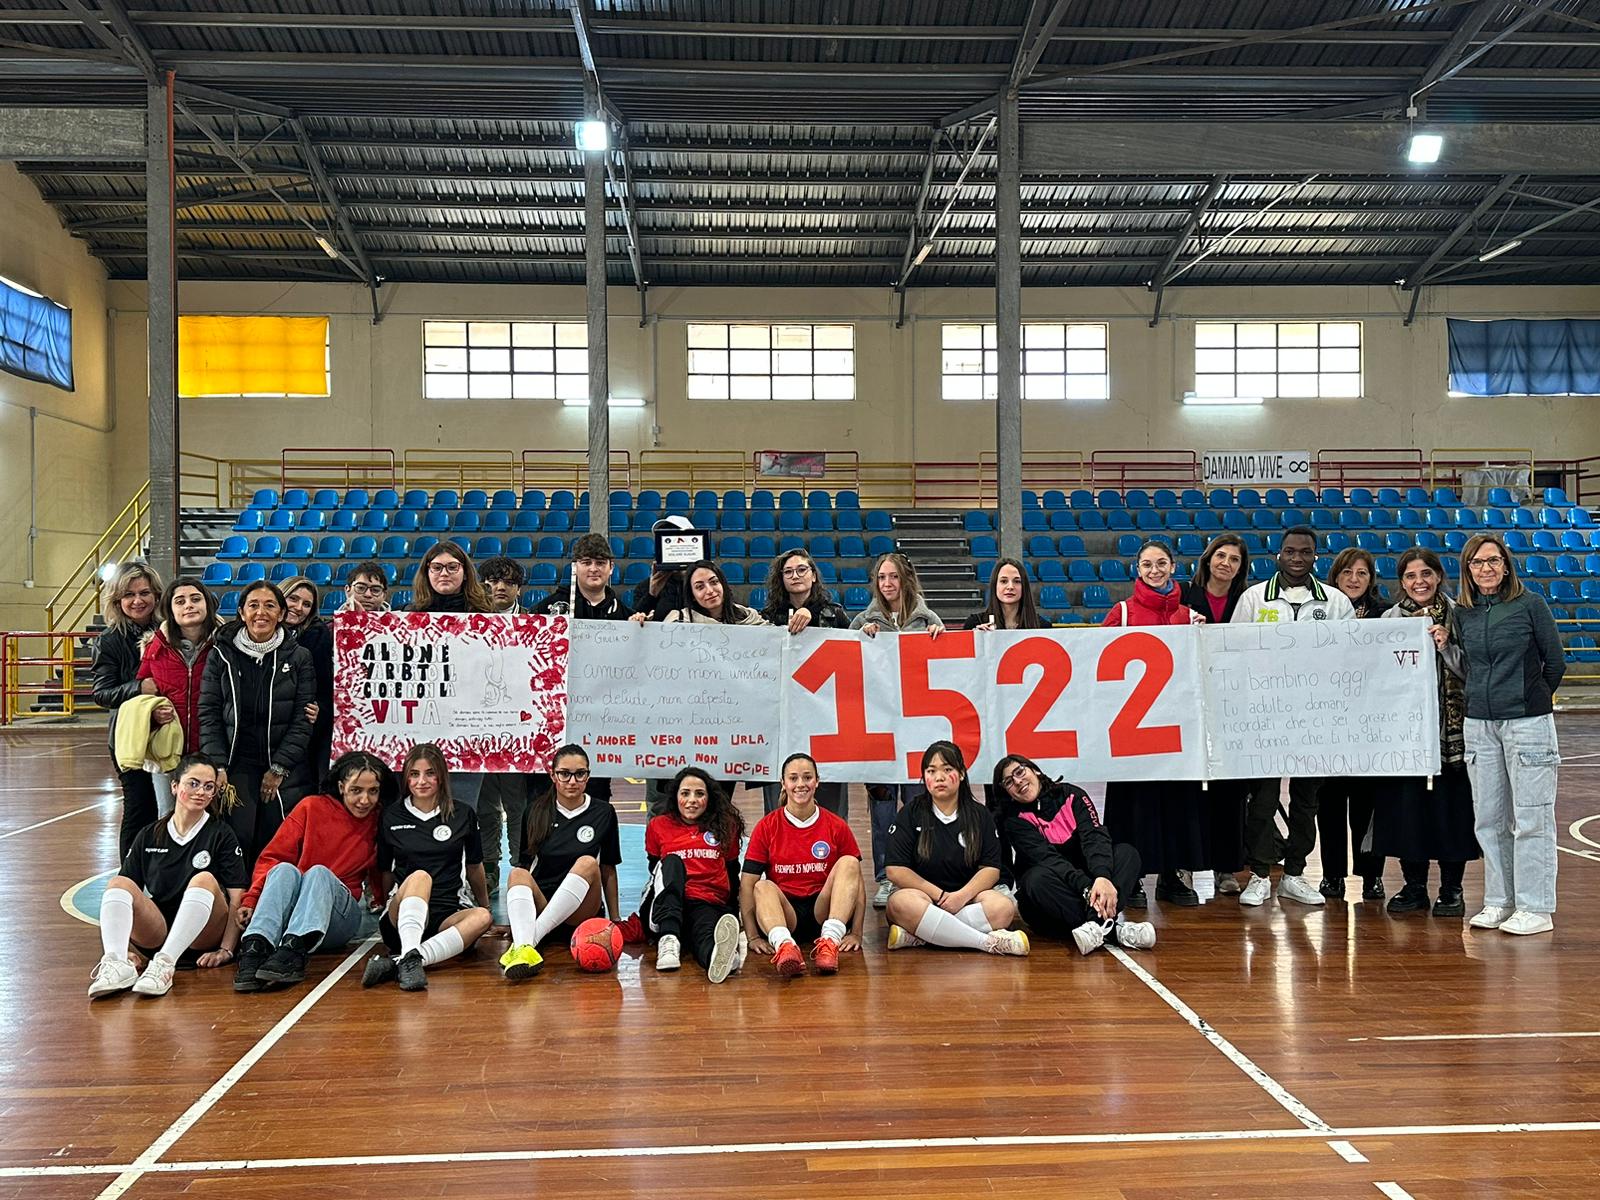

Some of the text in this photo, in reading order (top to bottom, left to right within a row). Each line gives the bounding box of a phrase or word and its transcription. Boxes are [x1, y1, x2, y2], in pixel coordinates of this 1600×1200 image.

[1203, 455, 1283, 479] DAMIANO VIVE
[1340, 619, 1408, 648] Rocco
[1393, 650, 1419, 669] VT
[1247, 664, 1319, 691] bambino
[406, 682, 435, 699] NON
[439, 682, 456, 698] LA
[371, 699, 441, 725] VITA
[791, 631, 1182, 779] 1522
[1249, 695, 1293, 713] adulto
[1222, 704, 1423, 734] ricordati che ci sei grazie ad
[650, 735, 683, 746] VERO
[694, 735, 718, 746] NON
[1223, 739, 1244, 751] una
[1254, 734, 1290, 750] donna
[1301, 729, 1324, 746] che
[1347, 727, 1360, 743] ha
[1366, 727, 1393, 744] dato
[1399, 726, 1421, 743] vita
[596, 753, 622, 764] NON
[696, 753, 718, 764] NON
[725, 762, 770, 776] UCCIDE
[1357, 749, 1433, 774] UCCIDERE
